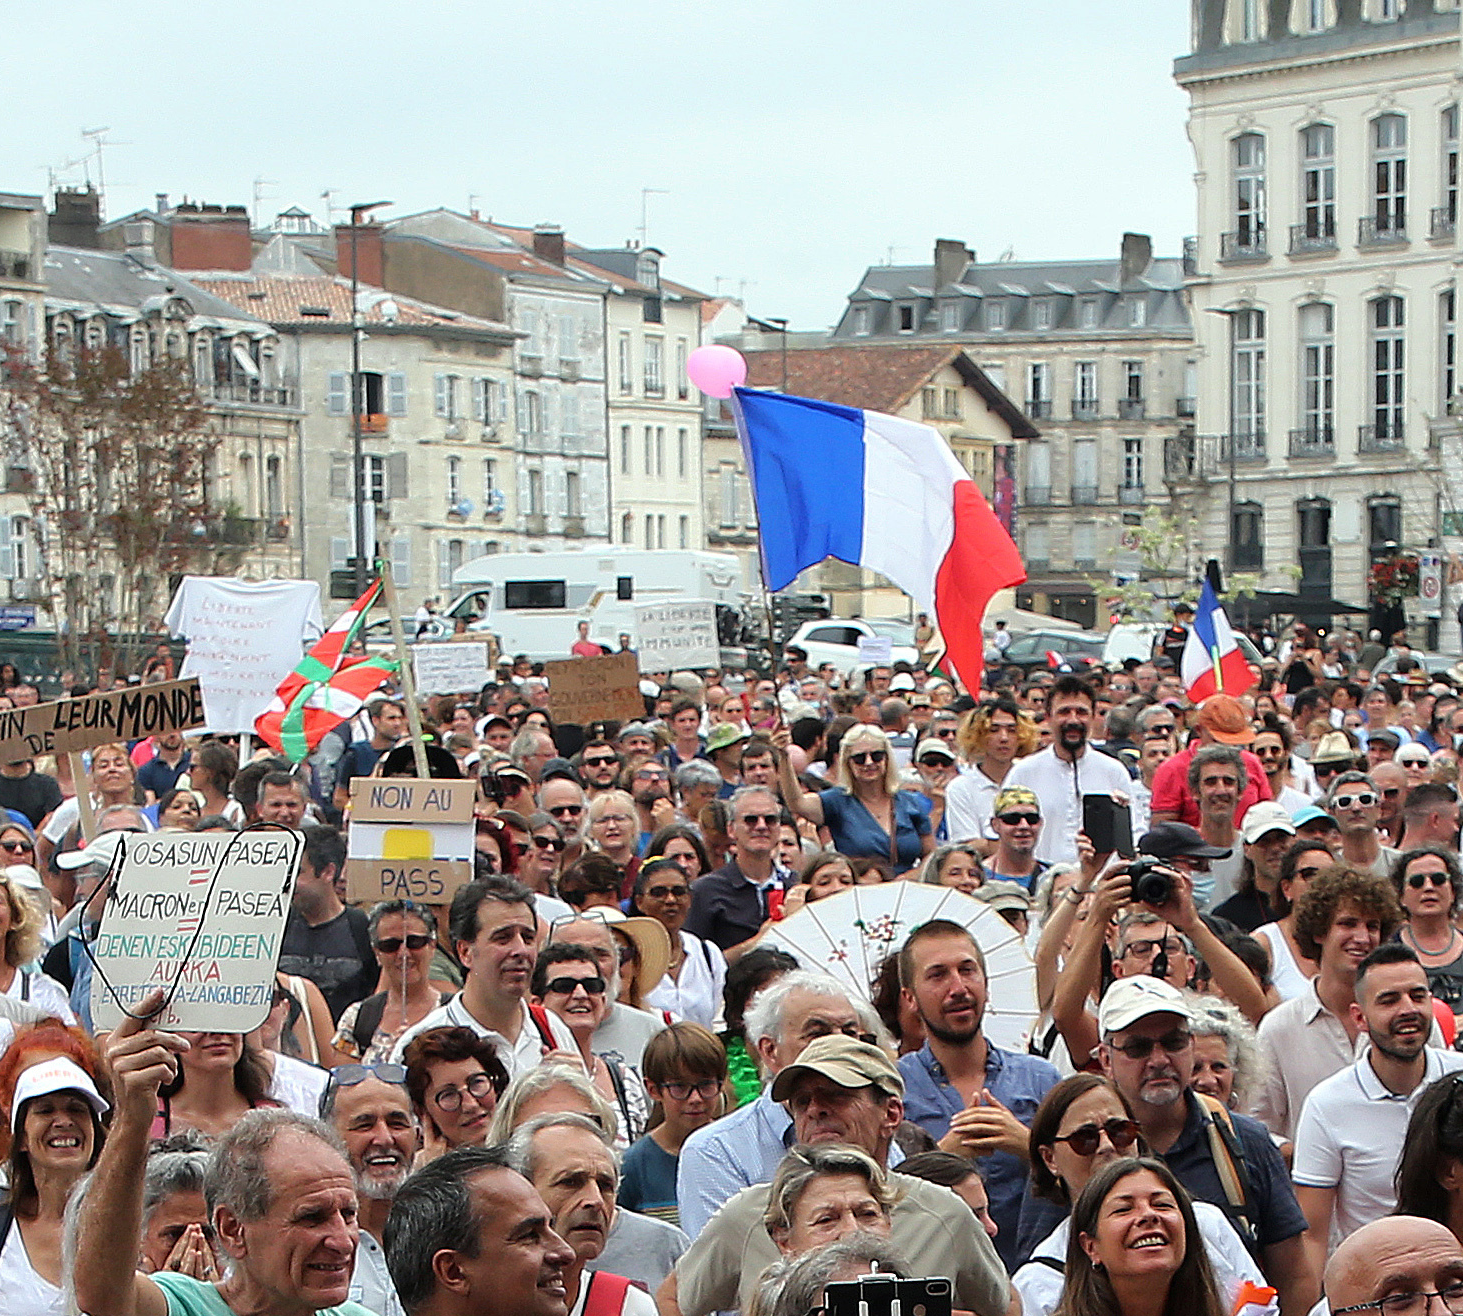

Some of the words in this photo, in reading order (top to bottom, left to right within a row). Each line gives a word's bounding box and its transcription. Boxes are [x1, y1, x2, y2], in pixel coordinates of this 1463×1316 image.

[24, 732, 55, 755] DE
[54, 698, 116, 733] LEUR
[115, 685, 206, 738] MONDE
[370, 785, 414, 811] NON
[423, 788, 452, 812] AU
[133, 841, 220, 868] OSASUN
[224, 840, 289, 867] PASEA
[380, 867, 445, 897] PASS
[214, 889, 284, 919] PASEA
[96, 932, 156, 959] DENEN
